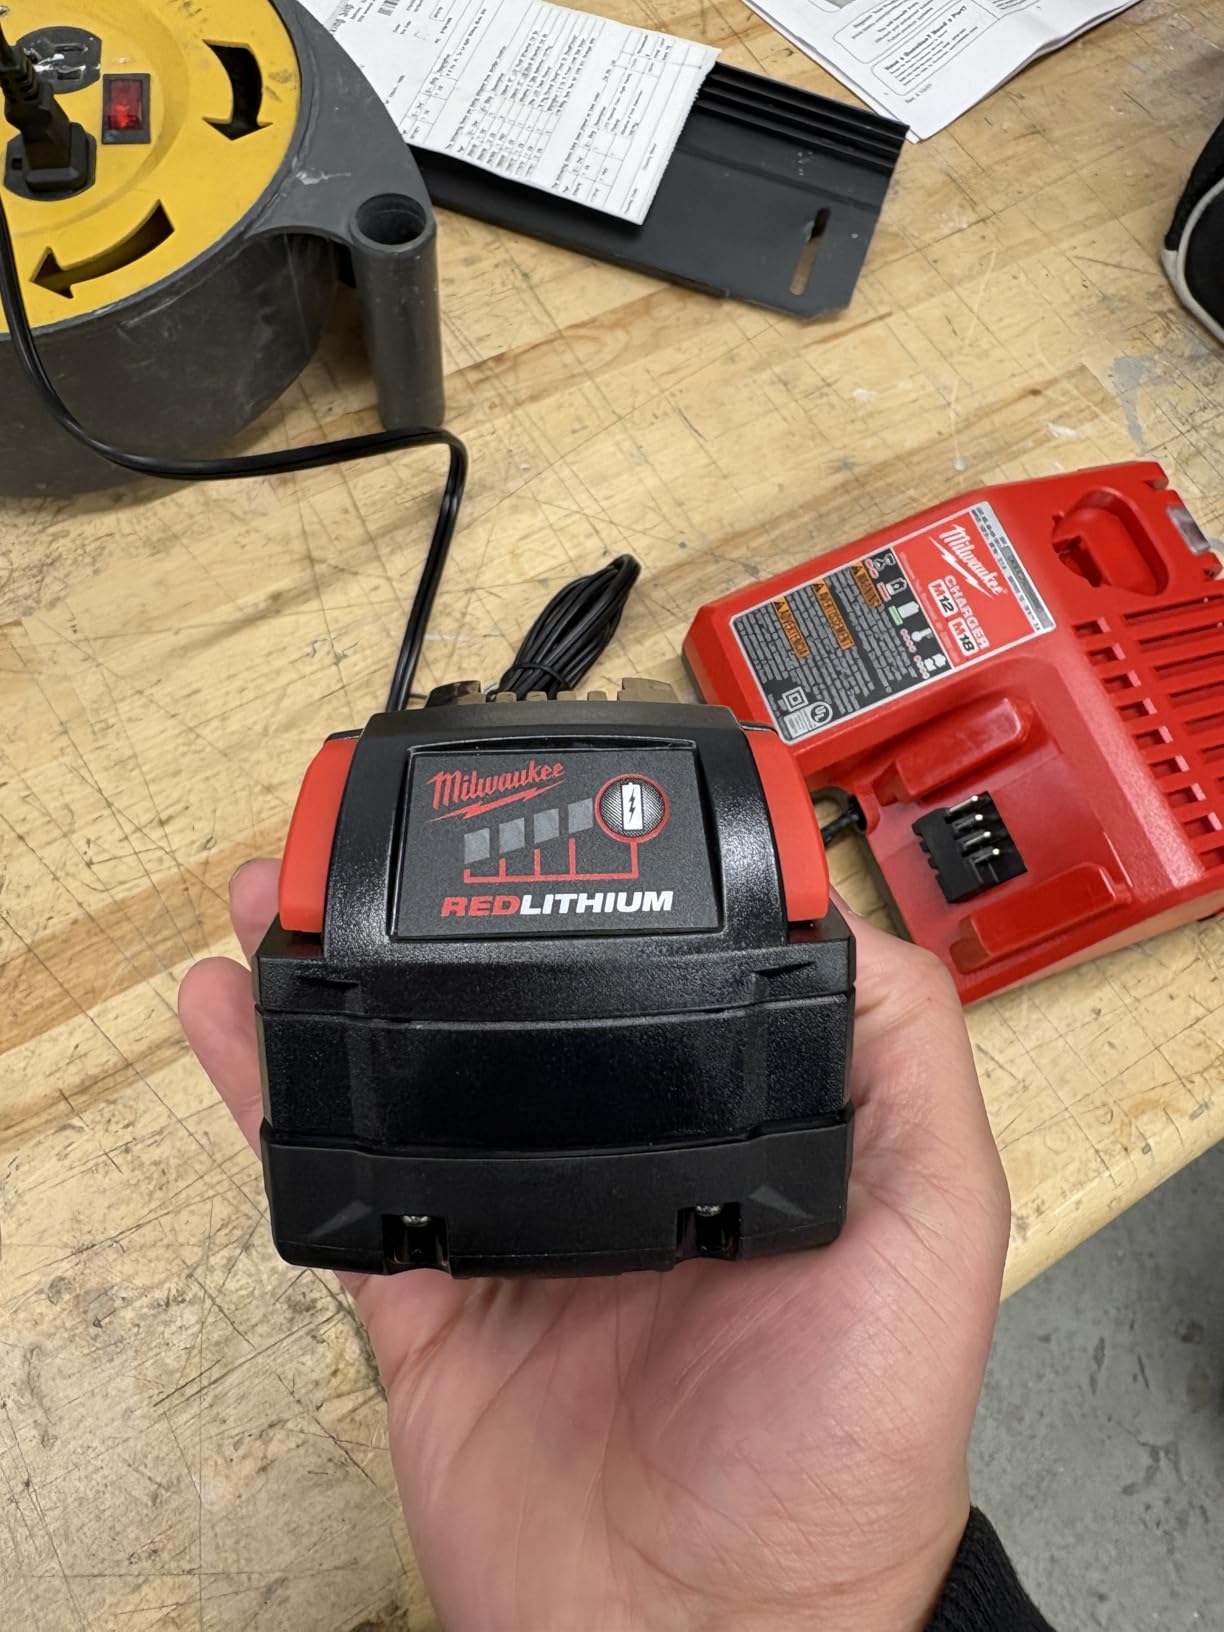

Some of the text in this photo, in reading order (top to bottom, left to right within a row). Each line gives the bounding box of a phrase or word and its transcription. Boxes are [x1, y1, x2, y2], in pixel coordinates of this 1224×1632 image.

[938, 524, 1004, 596] Milwaukee
[930, 581, 956, 614] M12
[950, 620, 977, 653] M18
[944, 575, 990, 650] CHARGER
[426, 759, 566, 810] Milwaukee
[440, 891, 674, 917] REDLITHIUM
